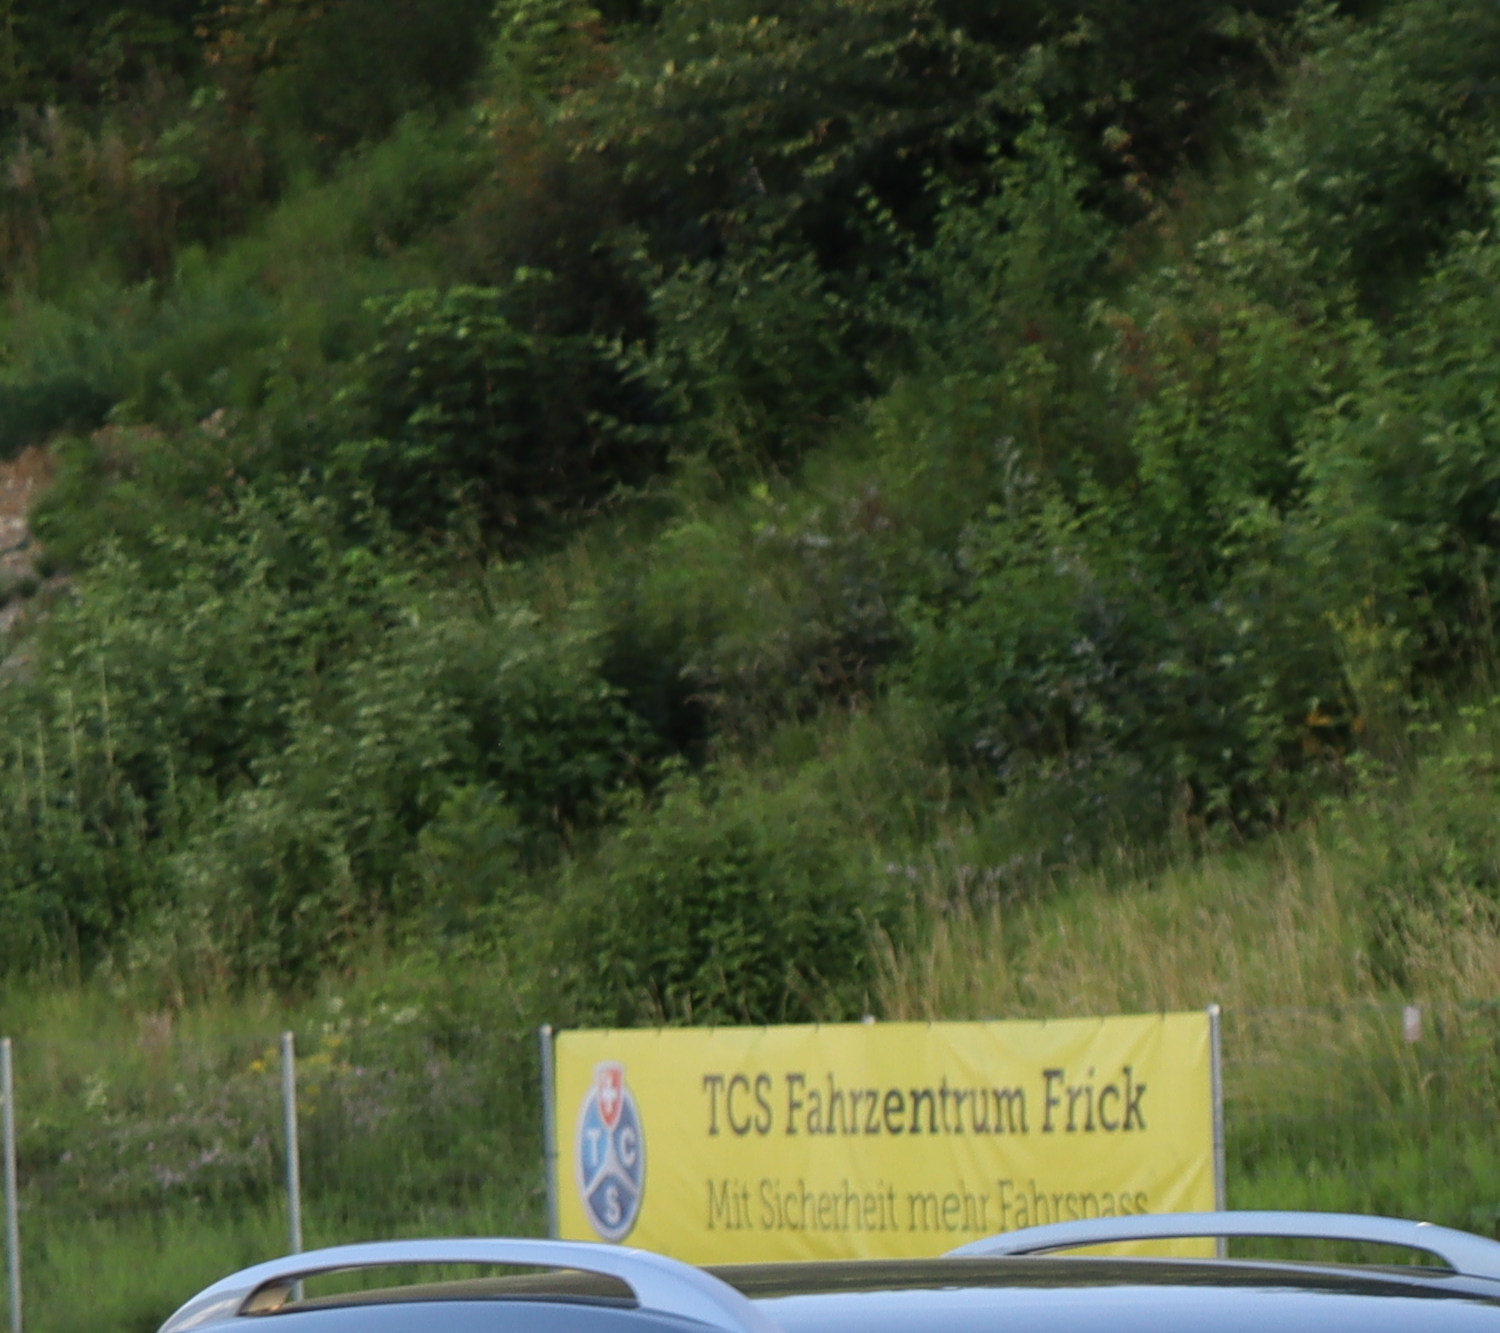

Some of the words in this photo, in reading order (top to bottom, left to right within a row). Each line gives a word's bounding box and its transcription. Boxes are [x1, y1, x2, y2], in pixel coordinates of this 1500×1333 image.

[703, 1072, 773, 1136] TCS
[785, 1072, 1029, 1136] Fahrzentrum
[1042, 1065, 1148, 1132] Frick
[707, 1178, 752, 1231] Mit
[760, 1177, 900, 1231] Sicherheit
[908, 1179, 989, 1232] mehr
